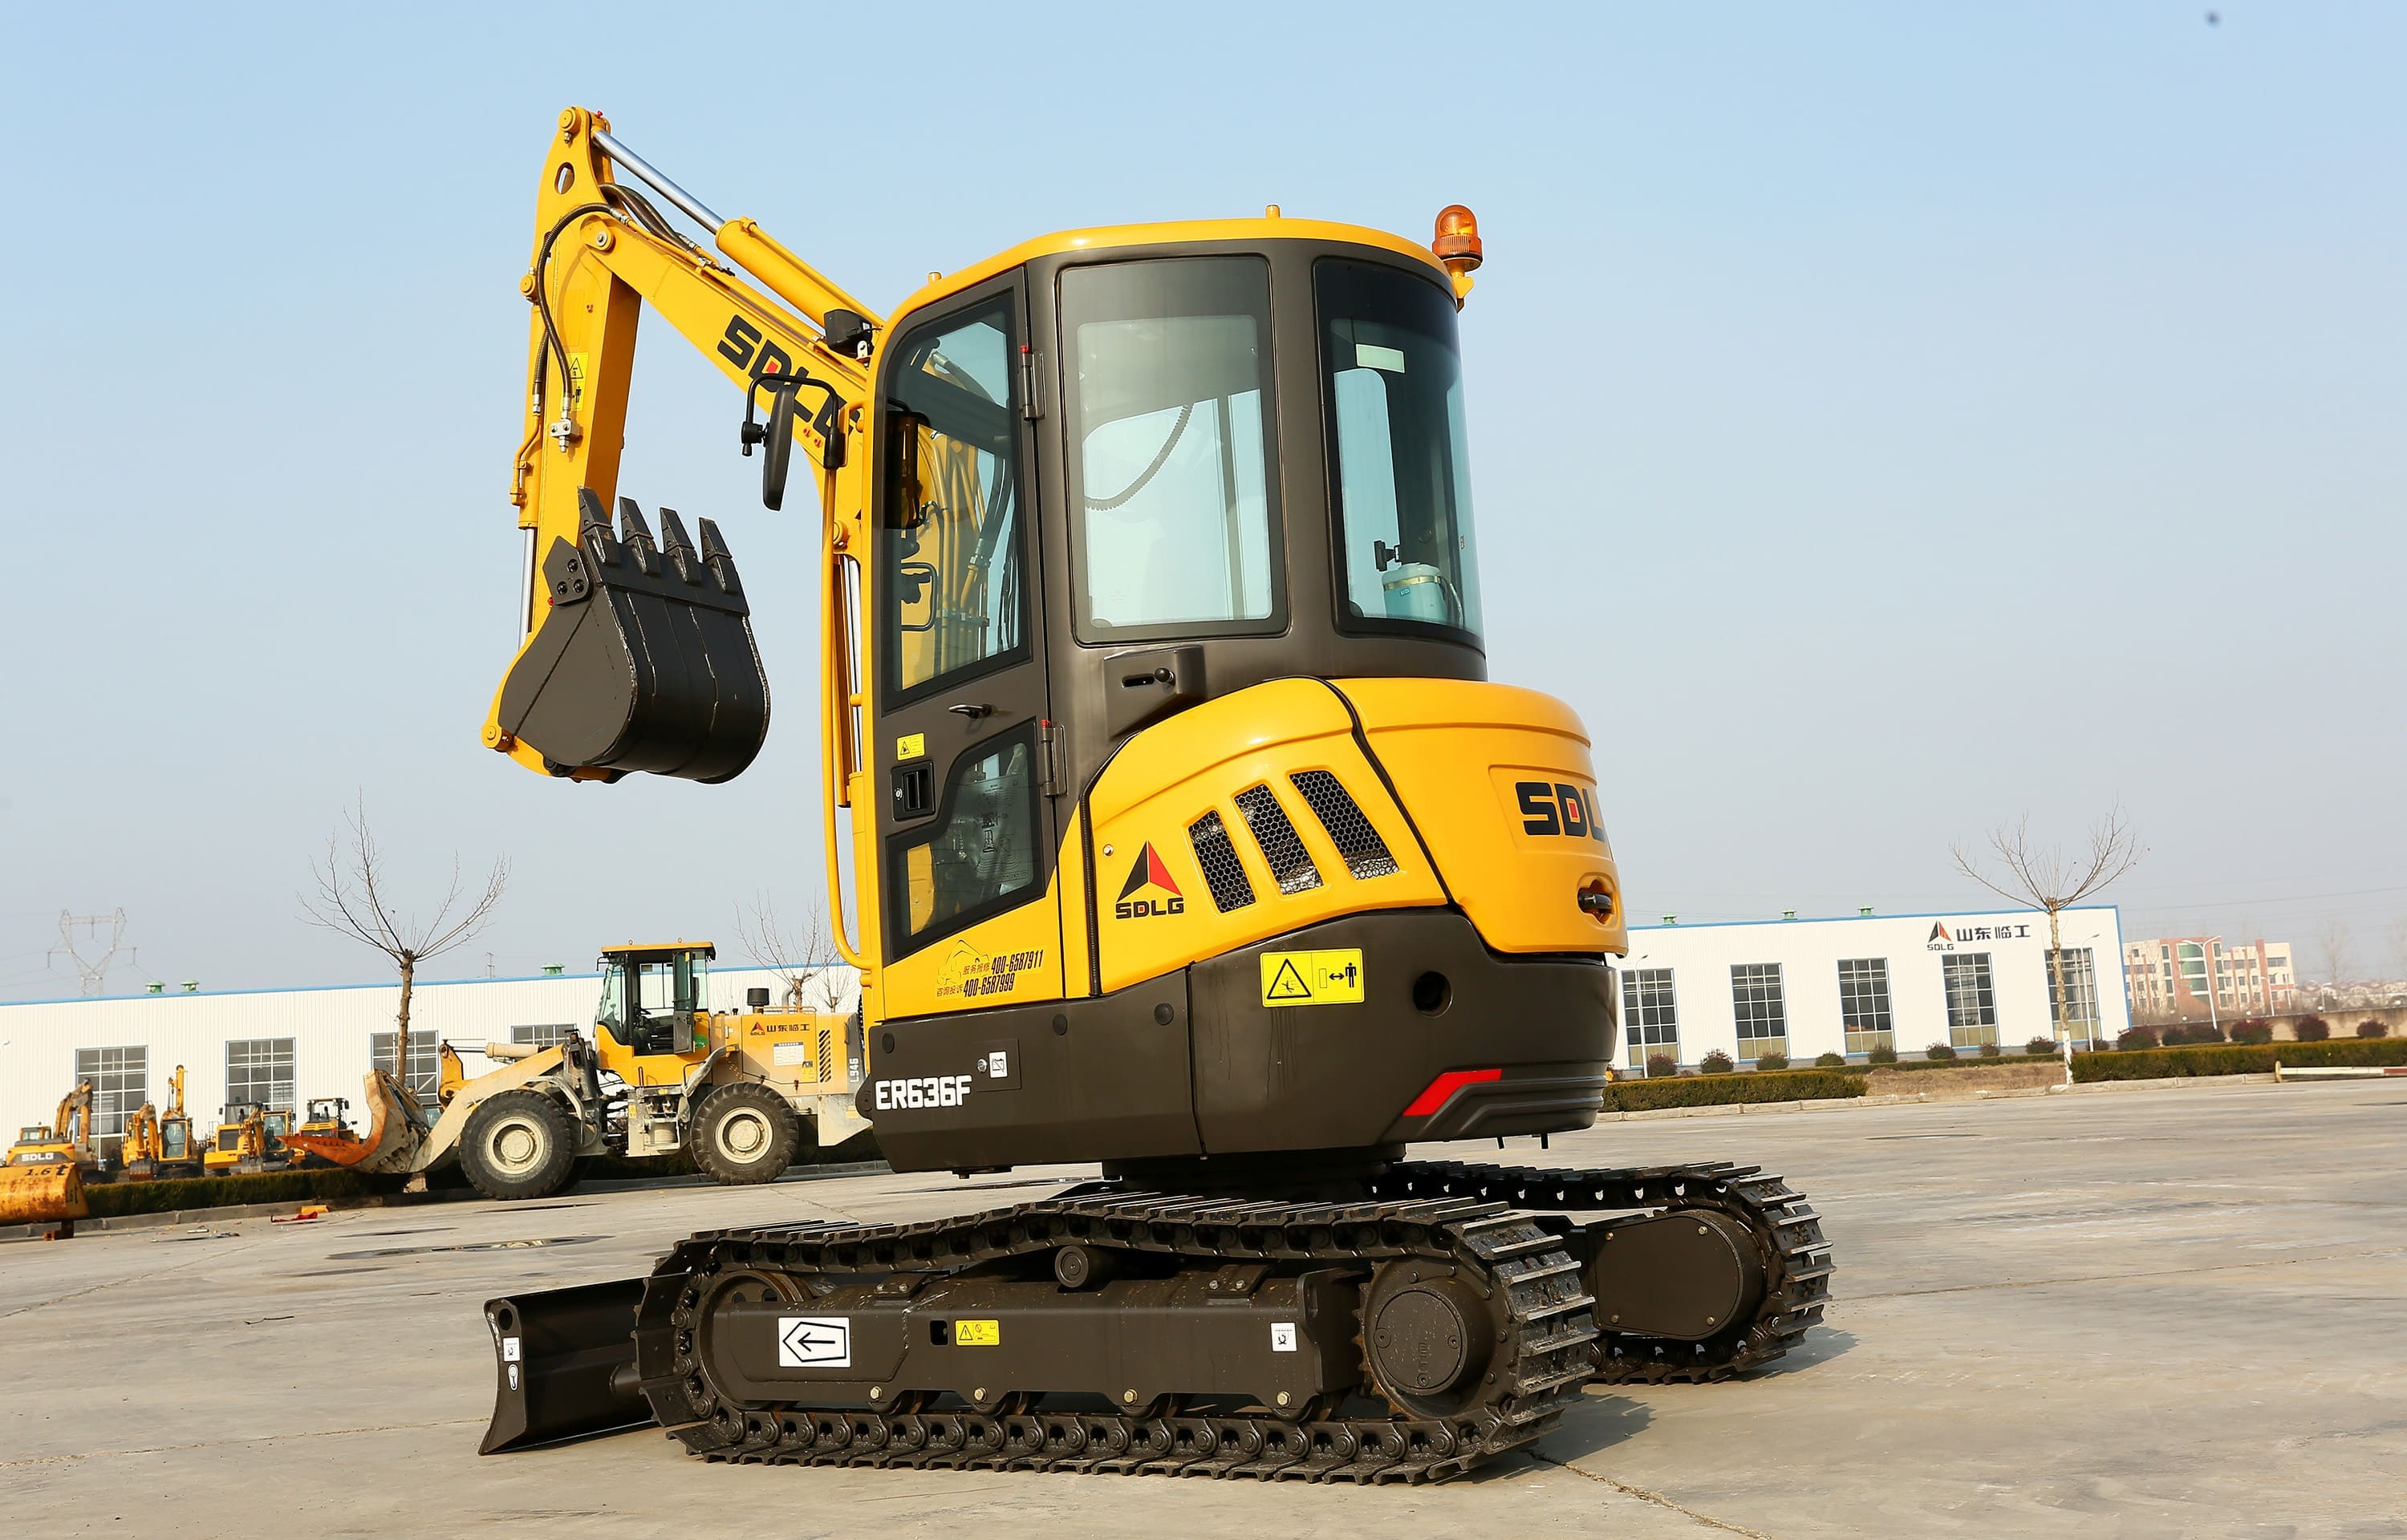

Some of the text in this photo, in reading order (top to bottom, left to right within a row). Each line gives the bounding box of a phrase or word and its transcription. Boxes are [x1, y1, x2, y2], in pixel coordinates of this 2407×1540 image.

[1516, 782, 1607, 842] SDL
[1116, 898, 1184, 919] SDLG
[1956, 925, 2031, 942] 山东临工
[991, 950, 1044, 975] 400-6587911
[963, 973, 1015, 997] 400-6587999
[766, 1023, 810, 1033] 山东临工
[875, 1075, 972, 1110] ER636F
[22, 1152, 54, 1161] SDLG
